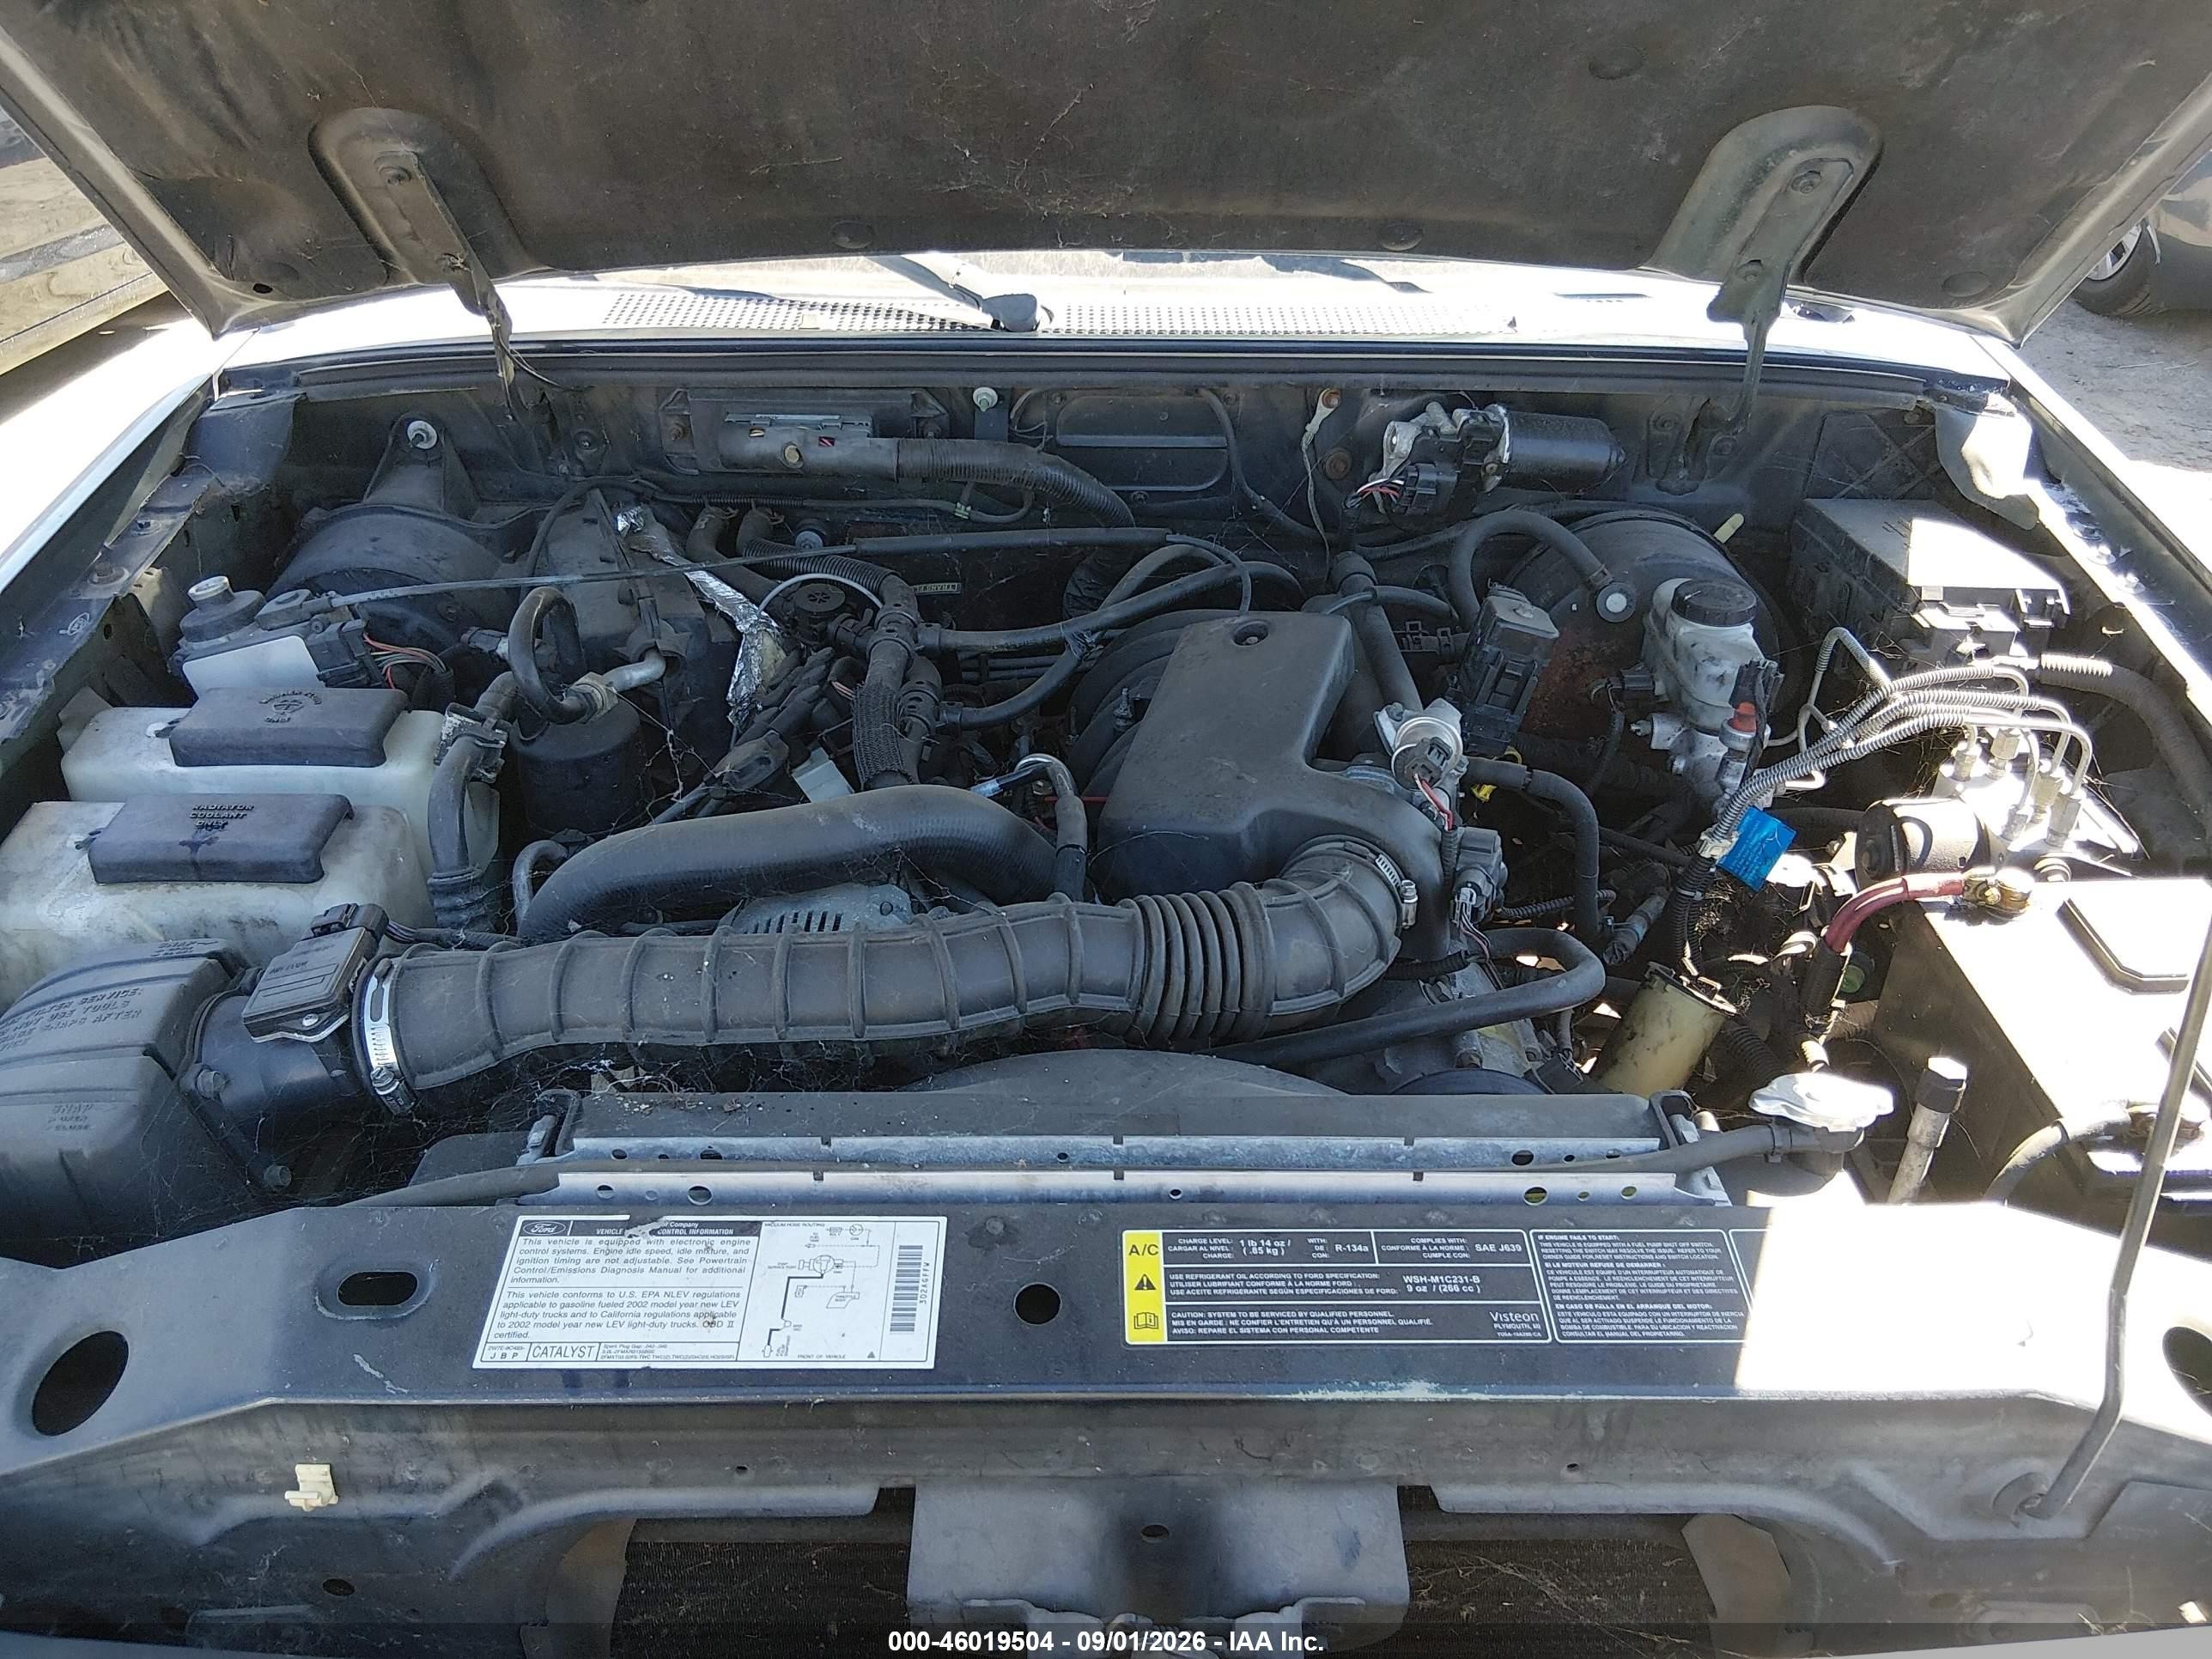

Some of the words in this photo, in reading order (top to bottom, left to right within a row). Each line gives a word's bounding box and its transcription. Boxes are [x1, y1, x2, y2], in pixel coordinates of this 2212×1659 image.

[82, 1000, 131, 1015] TOOLS
[92, 1009, 142, 1024] AFTER
[531, 1223, 557, 1233] Ford
[599, 1238, 641, 1247] equipped
[1129, 1244, 1159, 1256] A/C
[600, 1267, 645, 1275] Diagnosis
[1403, 1275, 1480, 1284] WSH-M1C231-B
[502, 1301, 547, 1310] applicable
[560, 1301, 595, 1310] gasoline
[500, 1310, 539, 1319] light-duty
[643, 1311, 690, 1320] regulations
[693, 1311, 737, 1320] applicable
[1490, 1311, 1539, 1322] Visteon
[628, 1321, 668, 1330] light-duty
[532, 1346, 595, 1358] CATALYST
